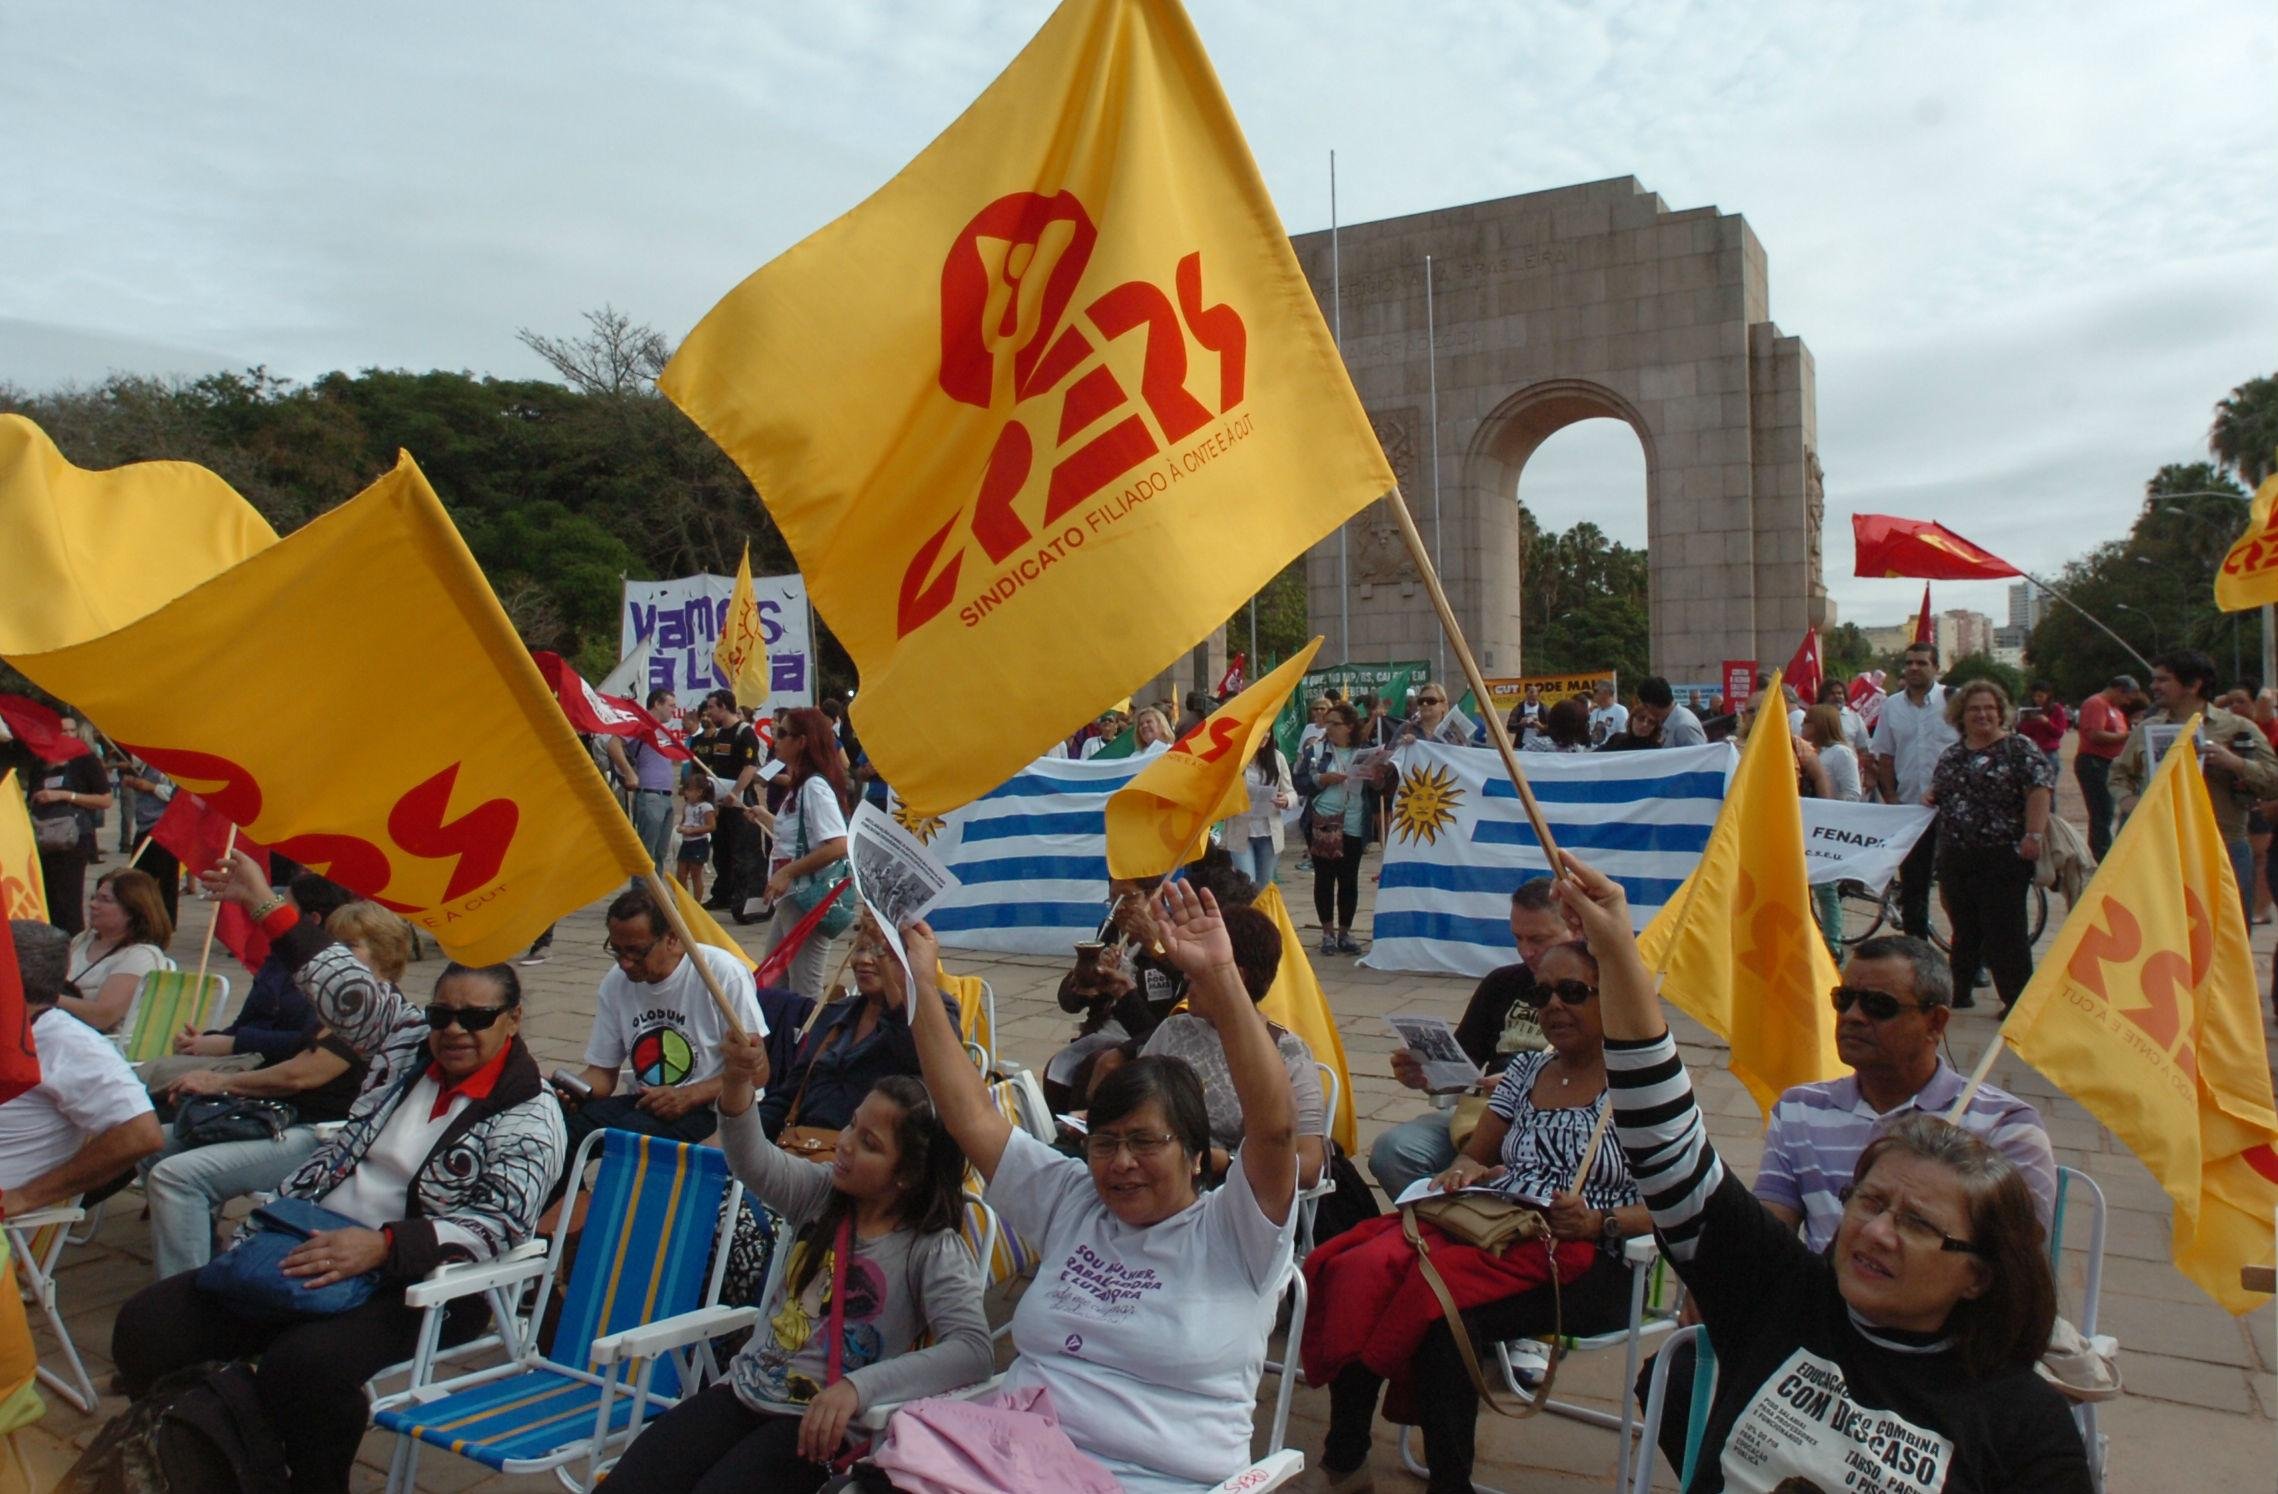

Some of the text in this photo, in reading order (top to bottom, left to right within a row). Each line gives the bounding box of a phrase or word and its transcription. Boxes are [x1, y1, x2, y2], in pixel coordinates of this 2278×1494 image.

[960, 526, 1085, 627] SINDICATO
[1085, 471, 1168, 534] FILIADO
[1166, 458, 1184, 482] À
[1183, 438, 1218, 472] CNTE
[1215, 432, 1228, 452] E
[1234, 412, 1254, 440] CUT
[1494, 684, 1520, 695] CUT
[1567, 679, 1597, 693] MAI
[464, 884, 508, 912] CUT
[632, 1008, 686, 1028] OLODUM
[1075, 1244, 1105, 1270] SOU
[1060, 1269, 1071, 1281] E
[1777, 1374, 1938, 1487] COM DESCASO
[1875, 1419, 1941, 1458] COMBINA
[1845, 1448, 1882, 1484] TARSO,
[1845, 1470, 1857, 1486] O
